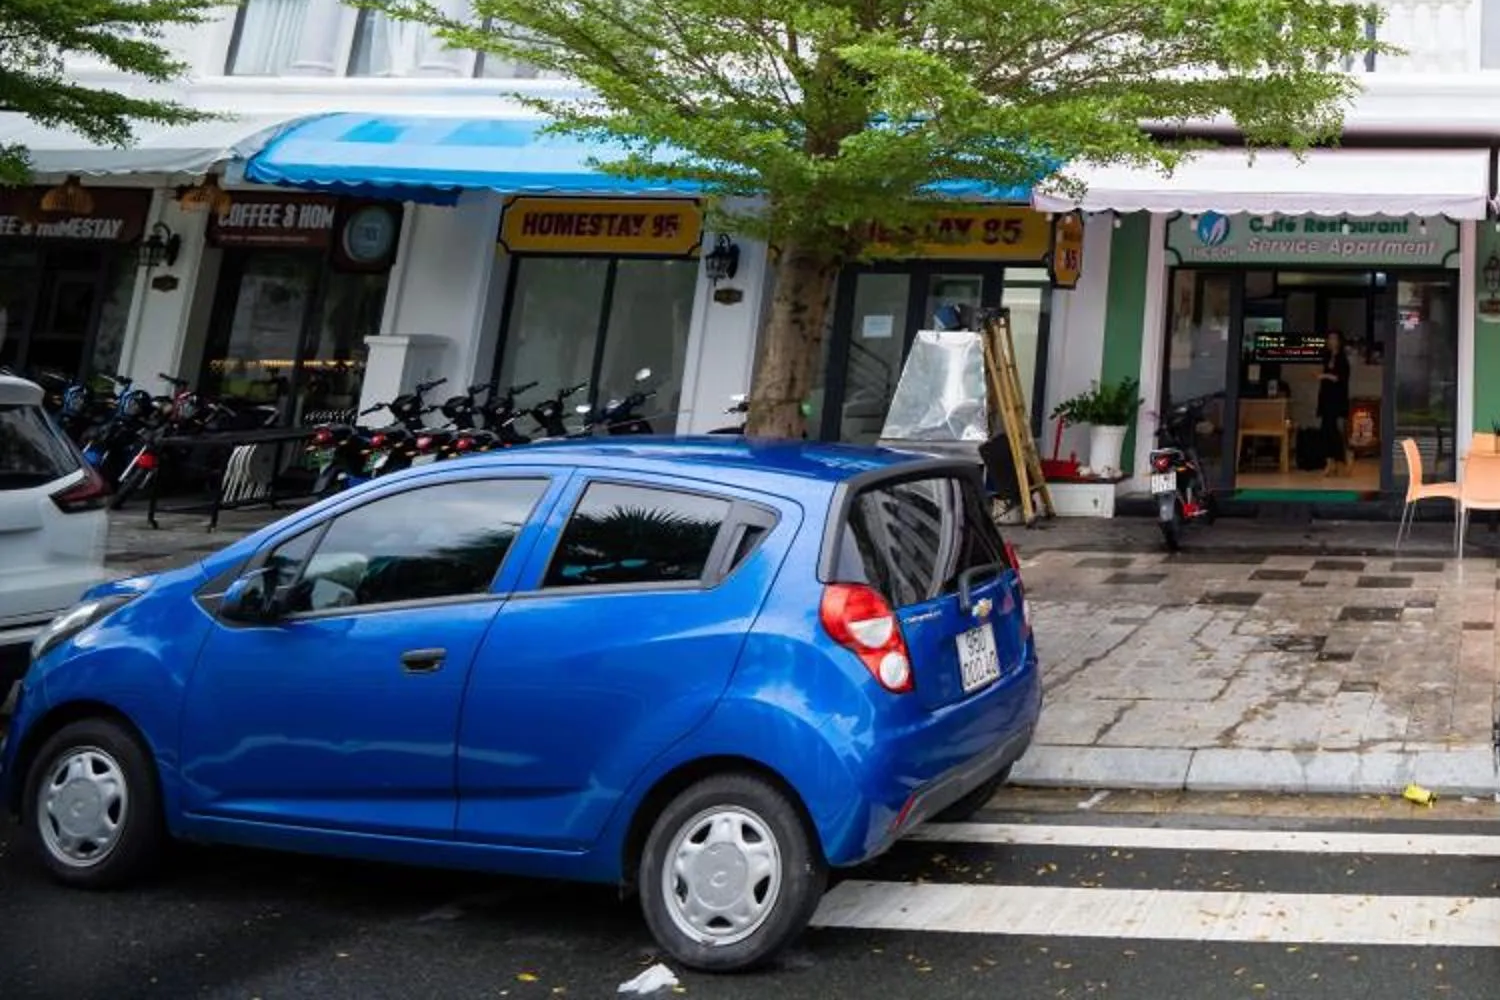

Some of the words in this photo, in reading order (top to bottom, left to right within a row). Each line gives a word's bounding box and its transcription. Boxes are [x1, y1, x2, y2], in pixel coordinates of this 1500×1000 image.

[217, 203, 282, 227] COFFEE
[522, 213, 647, 237] HOMESTAY
[652, 214, 681, 239] 95
[981, 217, 1024, 245] 95
[1247, 237, 1318, 254] Service
[1327, 238, 1436, 259] Apartment
